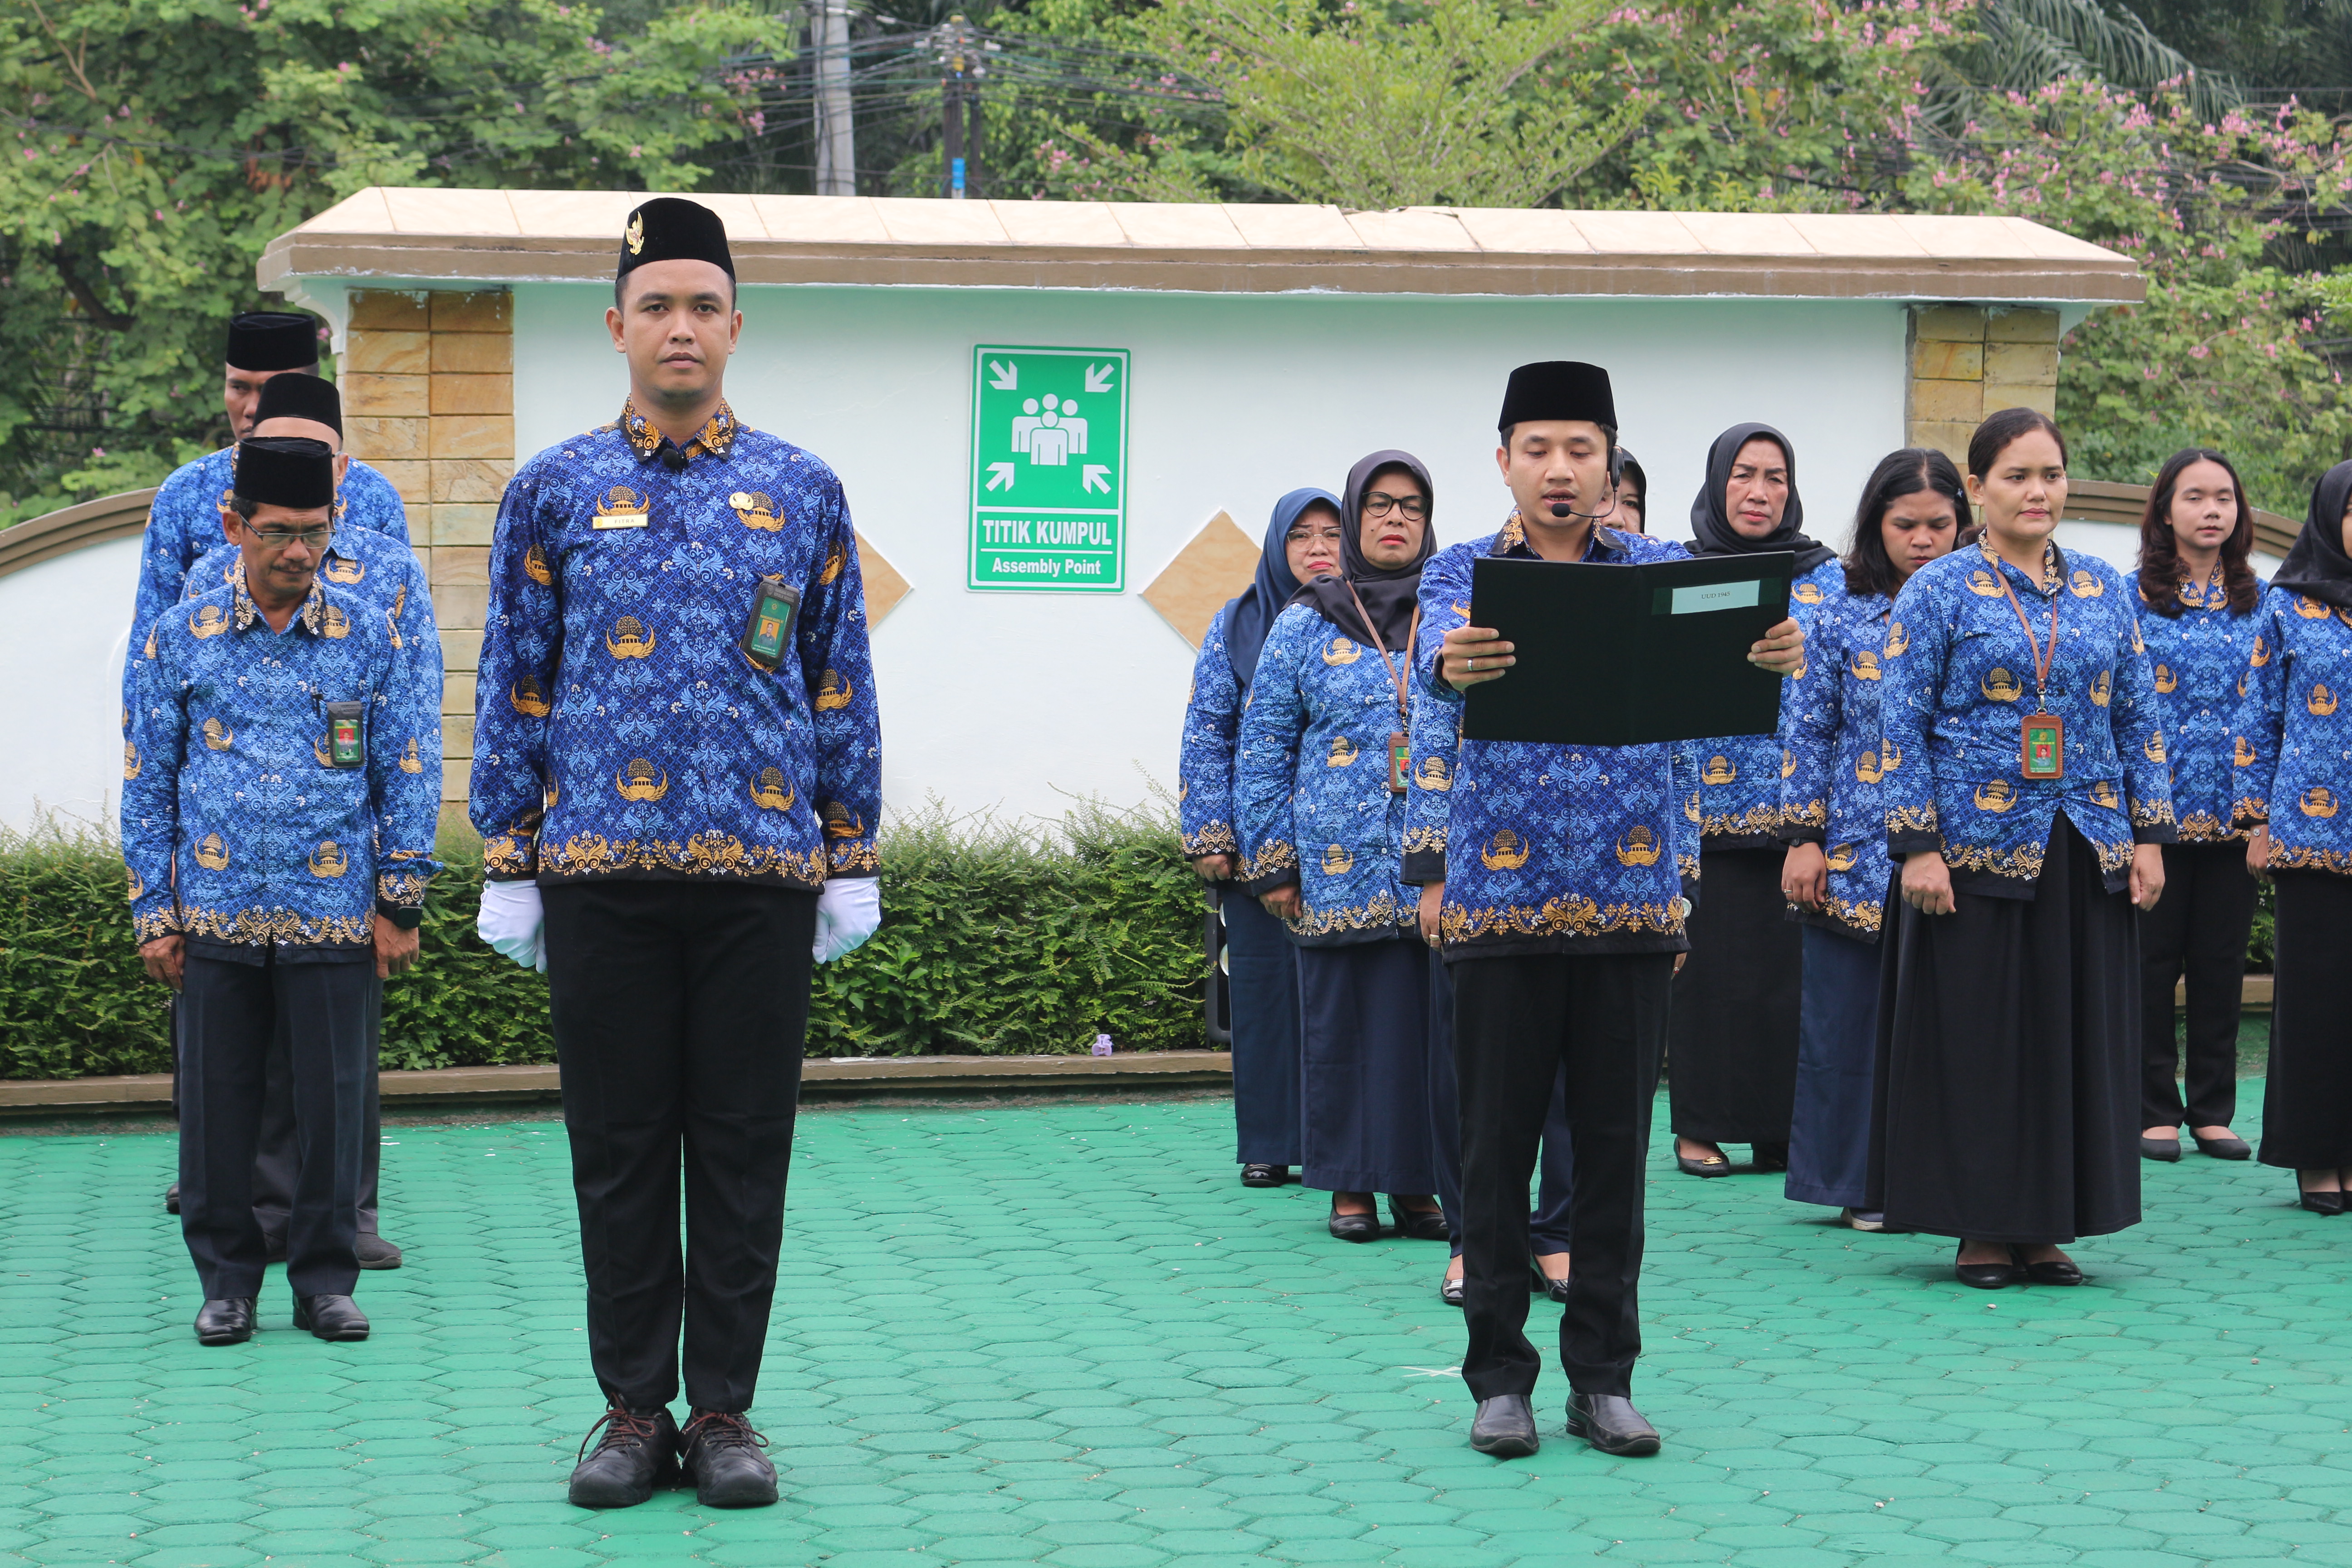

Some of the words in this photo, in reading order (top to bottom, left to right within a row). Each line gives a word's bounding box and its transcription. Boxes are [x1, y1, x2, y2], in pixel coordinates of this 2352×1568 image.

[983, 519, 1031, 544] TITIK
[1036, 521, 1112, 545] KUMPUL
[992, 557, 1061, 577] Assembly
[1065, 559, 1101, 574] Point
